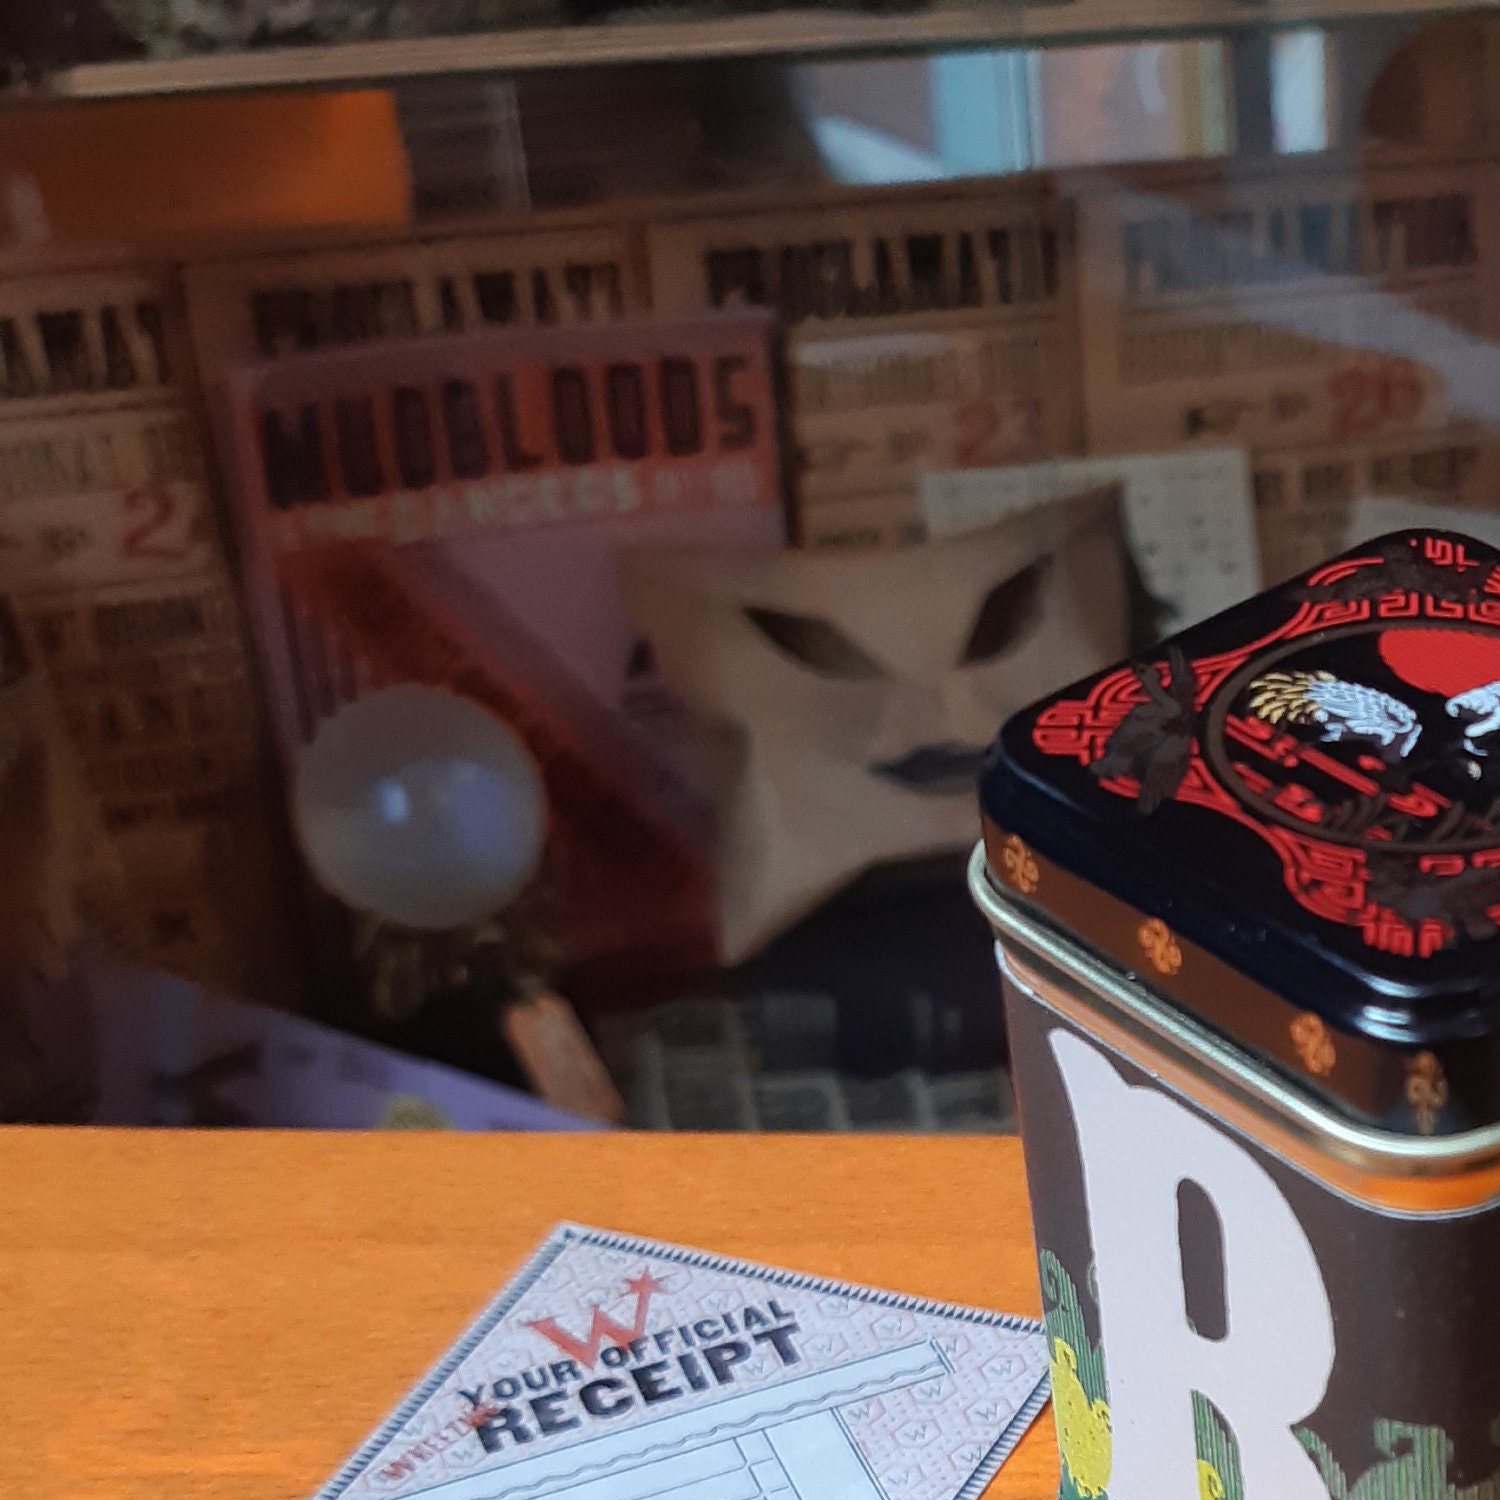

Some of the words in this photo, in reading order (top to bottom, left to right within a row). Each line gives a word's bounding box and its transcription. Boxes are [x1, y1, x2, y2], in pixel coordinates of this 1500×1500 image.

[459, 1359, 583, 1411] YOUR
[600, 1300, 795, 1369] OFFICIAL
[475, 1324, 801, 1455] RECEIPT
